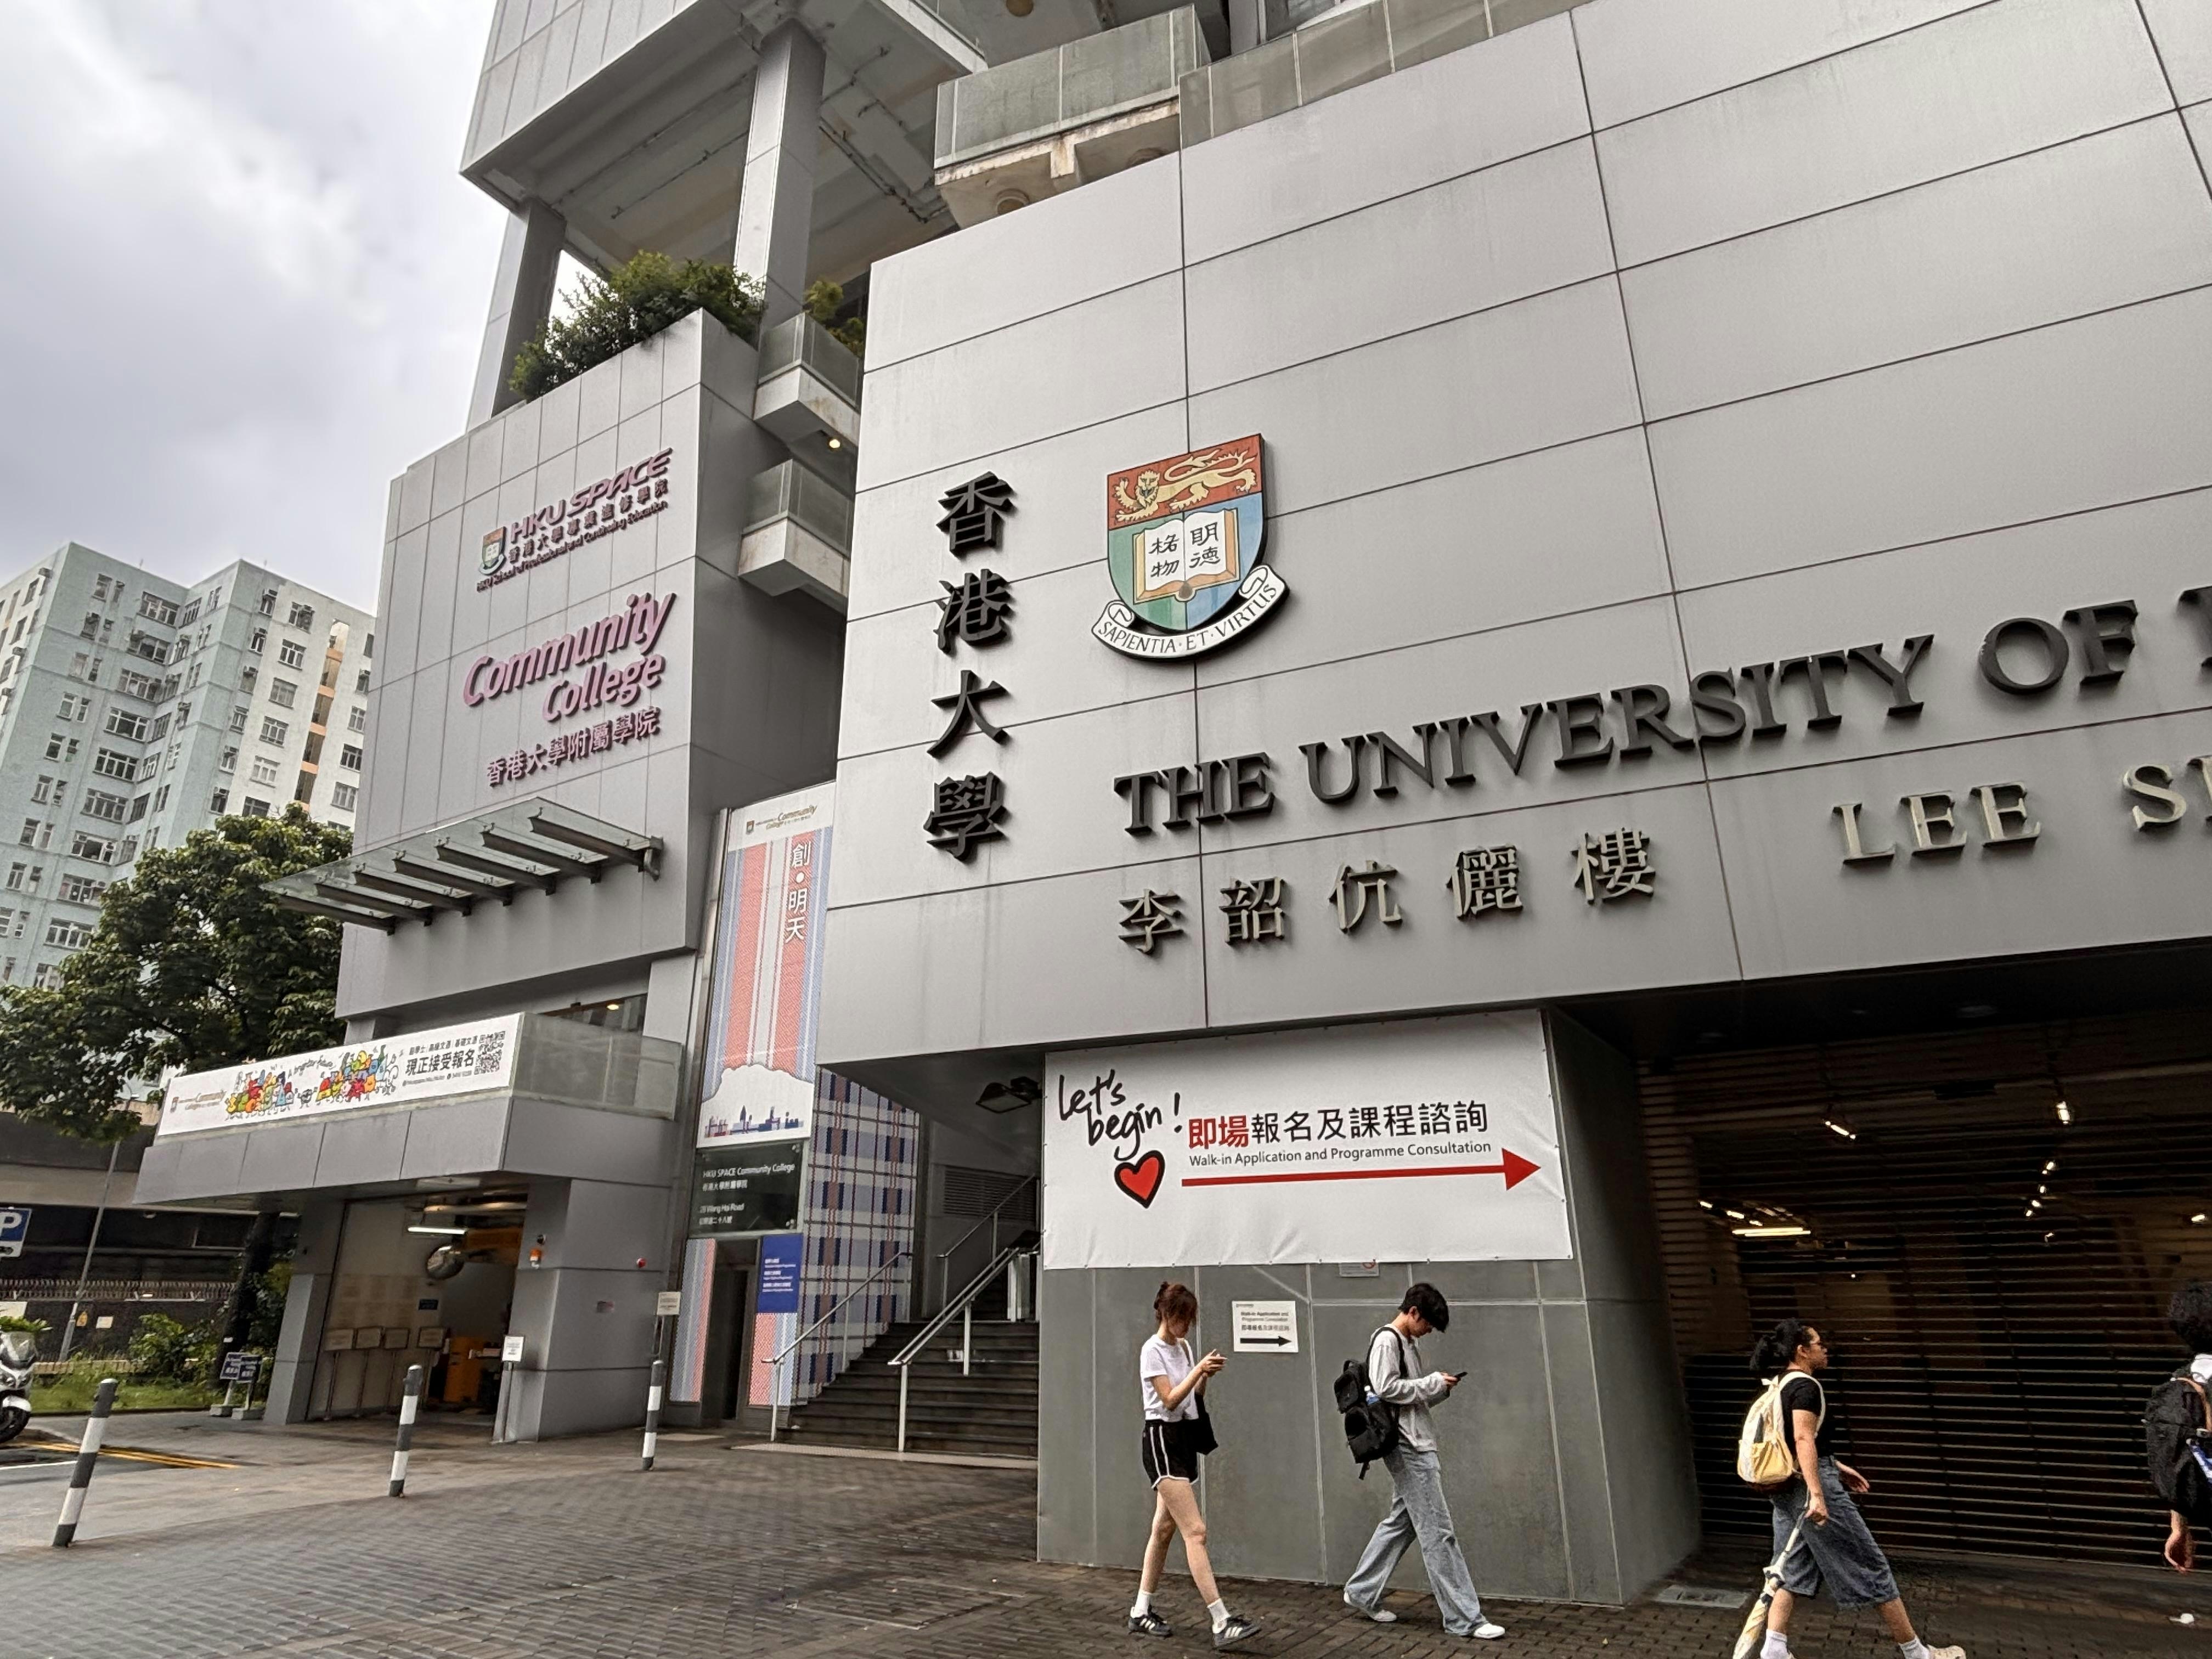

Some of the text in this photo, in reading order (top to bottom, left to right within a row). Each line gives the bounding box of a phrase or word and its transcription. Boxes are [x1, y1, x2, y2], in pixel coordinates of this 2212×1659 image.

[511, 447, 673, 544] HKU SPACE
[1149, 534, 1180, 578] 格物
[1189, 522, 1221, 568] 明德
[464, 592, 676, 706] Community
[1098, 584, 1277, 654] SAPIENTIA ET VIRTUS
[543, 653, 665, 722] College
[923, 471, 1014, 861] 香港大學
[488, 706, 661, 787] 香港大學附屬學院
[1114, 752, 1276, 835] THE
[1299, 634, 1934, 804] UNIVERSITY
[1978, 599, 2138, 695] OF
[1833, 781, 2041, 866] LEE
[1117, 828, 1657, 954] 李韶伉儷樓
[405, 1048, 475, 1076] 現正接受報名
[1059, 1069, 1126, 1121] Let's
[1189, 1141, 1491, 1170] Walk-in Application and Programme Consultation
[0, 1212, 22, 1236] P
